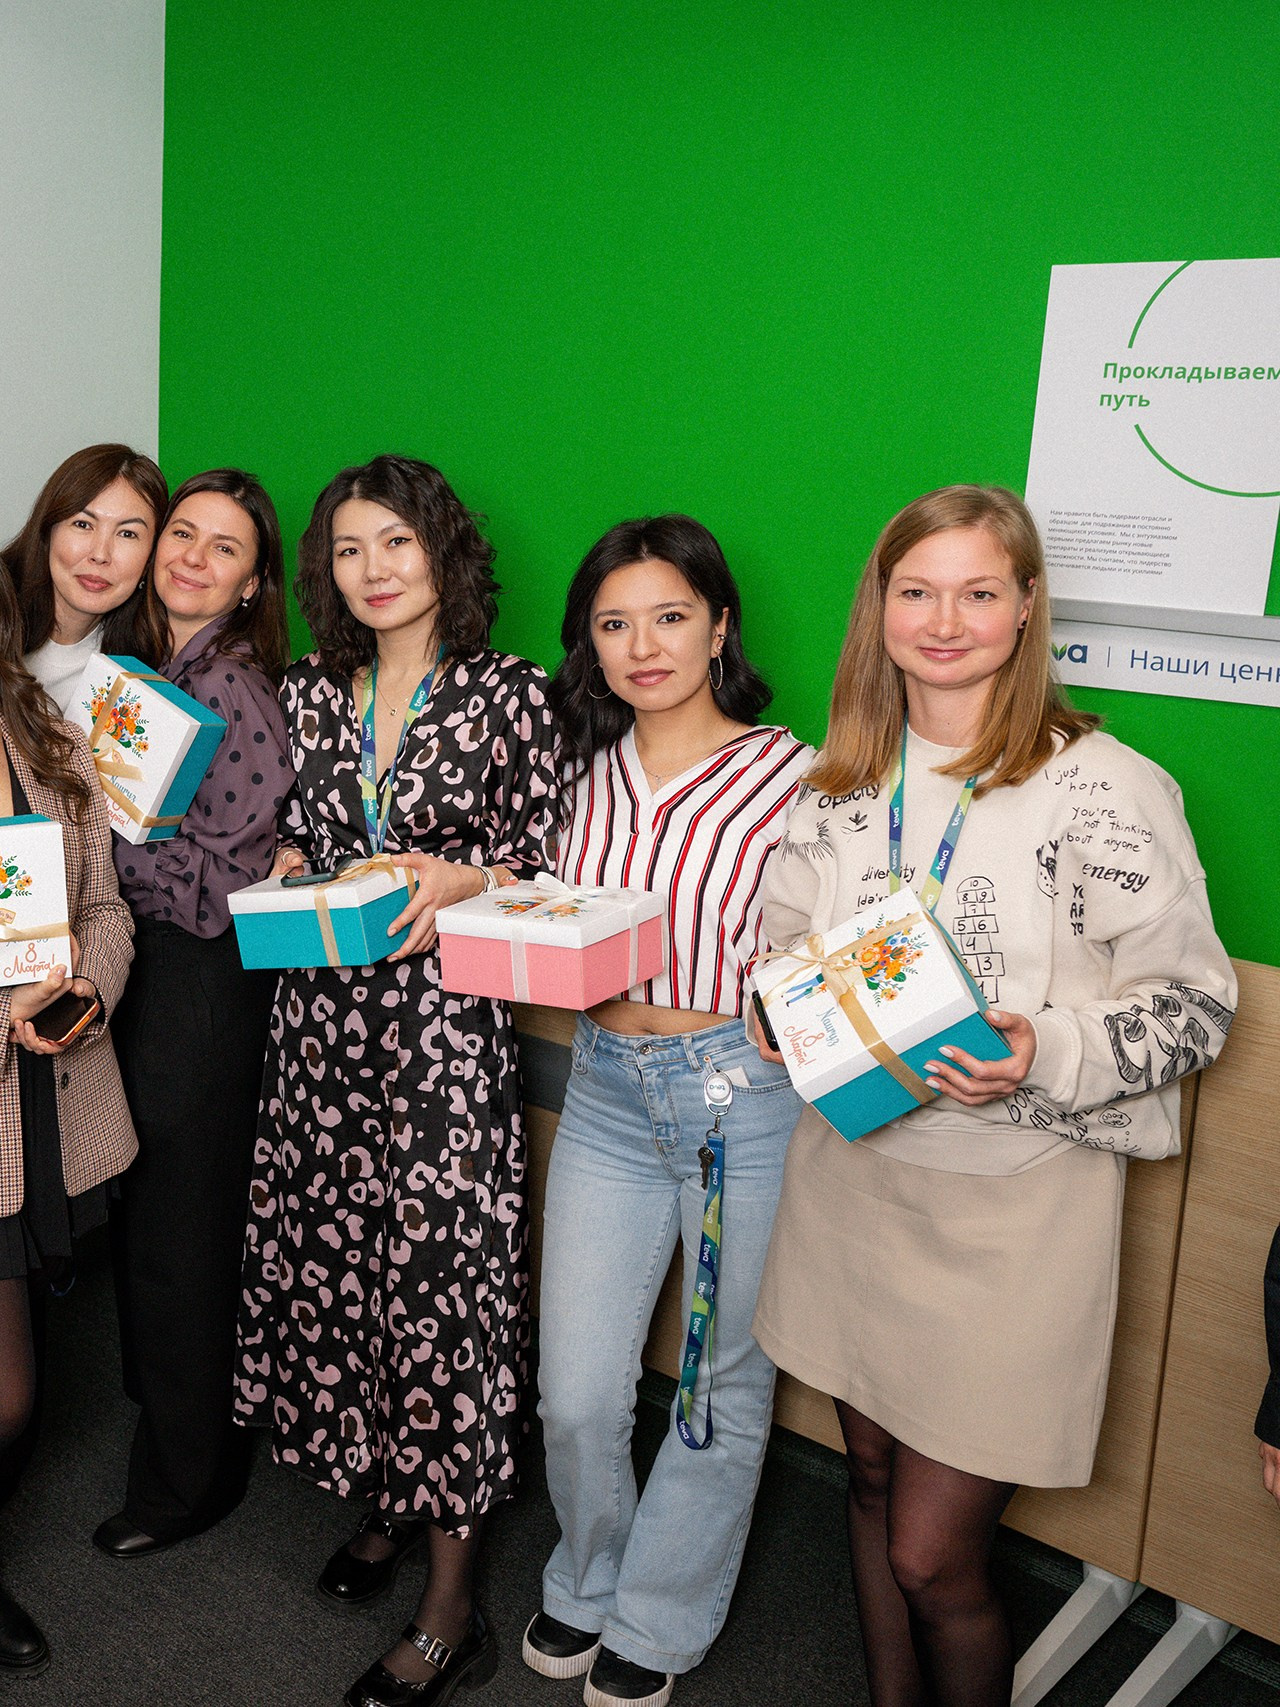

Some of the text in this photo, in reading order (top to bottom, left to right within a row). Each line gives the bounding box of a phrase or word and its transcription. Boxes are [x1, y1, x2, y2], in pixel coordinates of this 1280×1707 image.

[1099, 394, 1151, 412] путь
[1130, 649, 1280, 684] Наши цен
[414, 690, 426, 708] teva
[365, 759, 373, 779] teva
[1054, 764, 1080, 786] just
[1068, 781, 1113, 796] hope
[367, 796, 375, 815] teva
[1071, 806, 1118, 821] you're
[892, 806, 901, 829] teva
[951, 805, 965, 827] teva
[1082, 819, 1153, 844] not thinking
[1103, 837, 1141, 853] anyone
[935, 849, 950, 871] teva
[861, 863, 917, 884] diverity
[1081, 863, 1151, 894] energy
[969, 879, 979, 888] 10
[962, 890, 988, 902] 8 9
[957, 919, 987, 932] 5 6
[25, 942, 37, 963] 8
[965, 936, 977, 951] 4
[982, 955, 993, 971] 3
[816, 1006, 840, 1048] Nauryz
[783, 1025, 817, 1069] Марта!
[802, 1032, 826, 1048] 8
[702, 1243, 712, 1262] teva
[692, 1317, 702, 1335] teva
[686, 1352, 697, 1369] teva
[678, 1419, 690, 1441] teva
